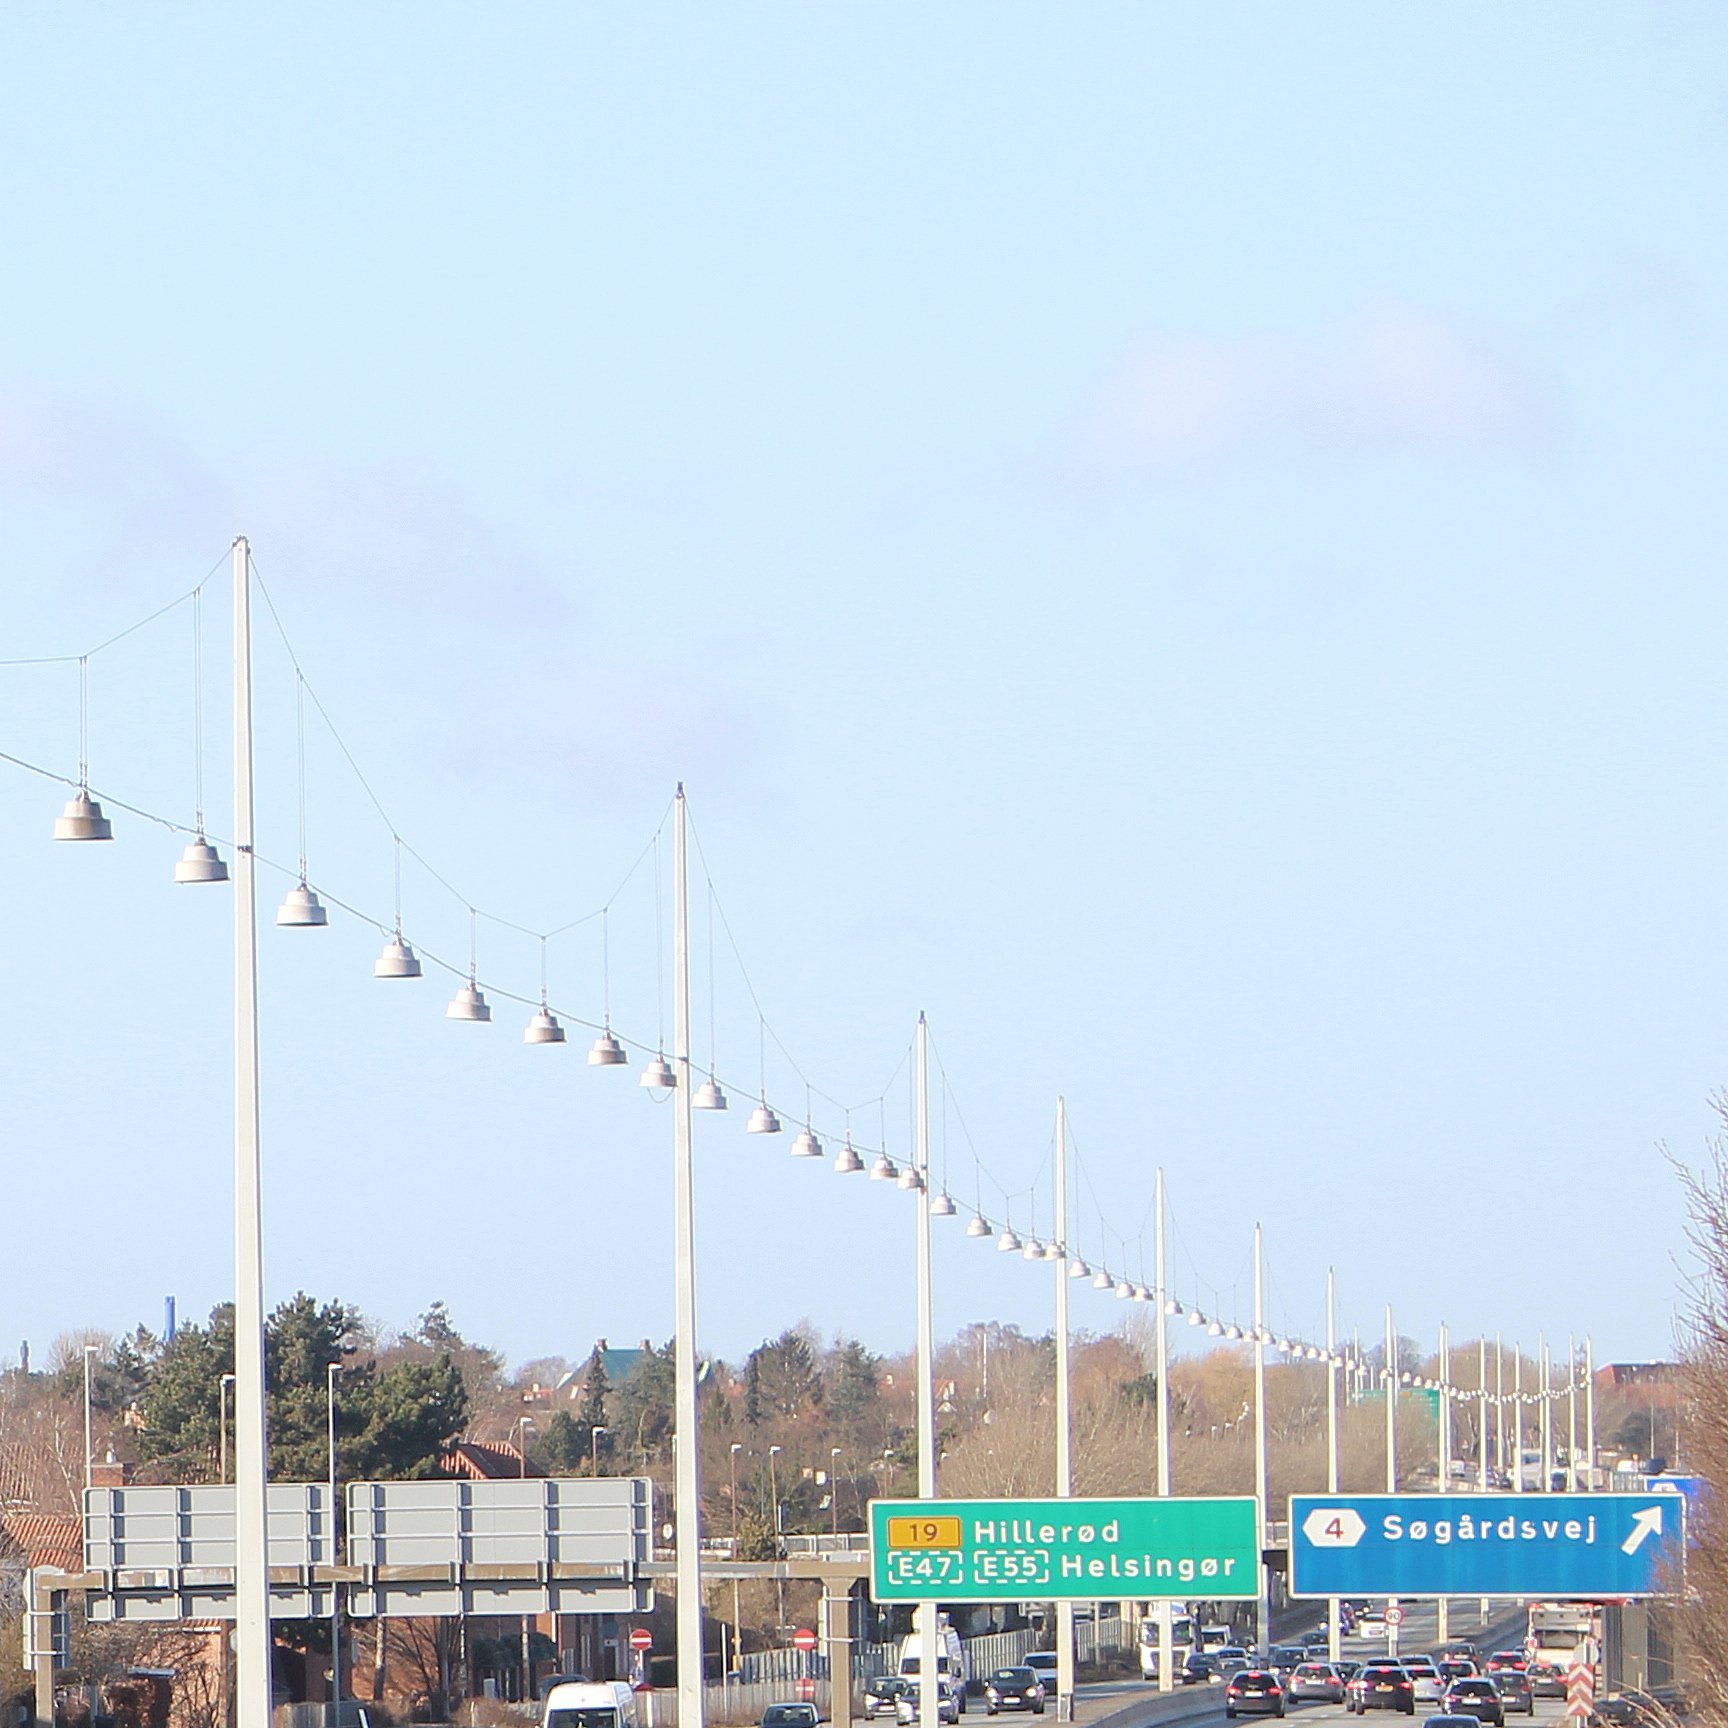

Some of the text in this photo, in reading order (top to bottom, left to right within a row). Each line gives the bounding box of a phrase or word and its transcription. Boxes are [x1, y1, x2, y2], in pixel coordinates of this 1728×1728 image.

[909, 1519, 1120, 1544] 19 Hillerød
[1324, 1517, 1345, 1540] 4
[1382, 1513, 1597, 1545] Søgårdsvej
[898, 1553, 1236, 1583] E47 E55 Helsingør
